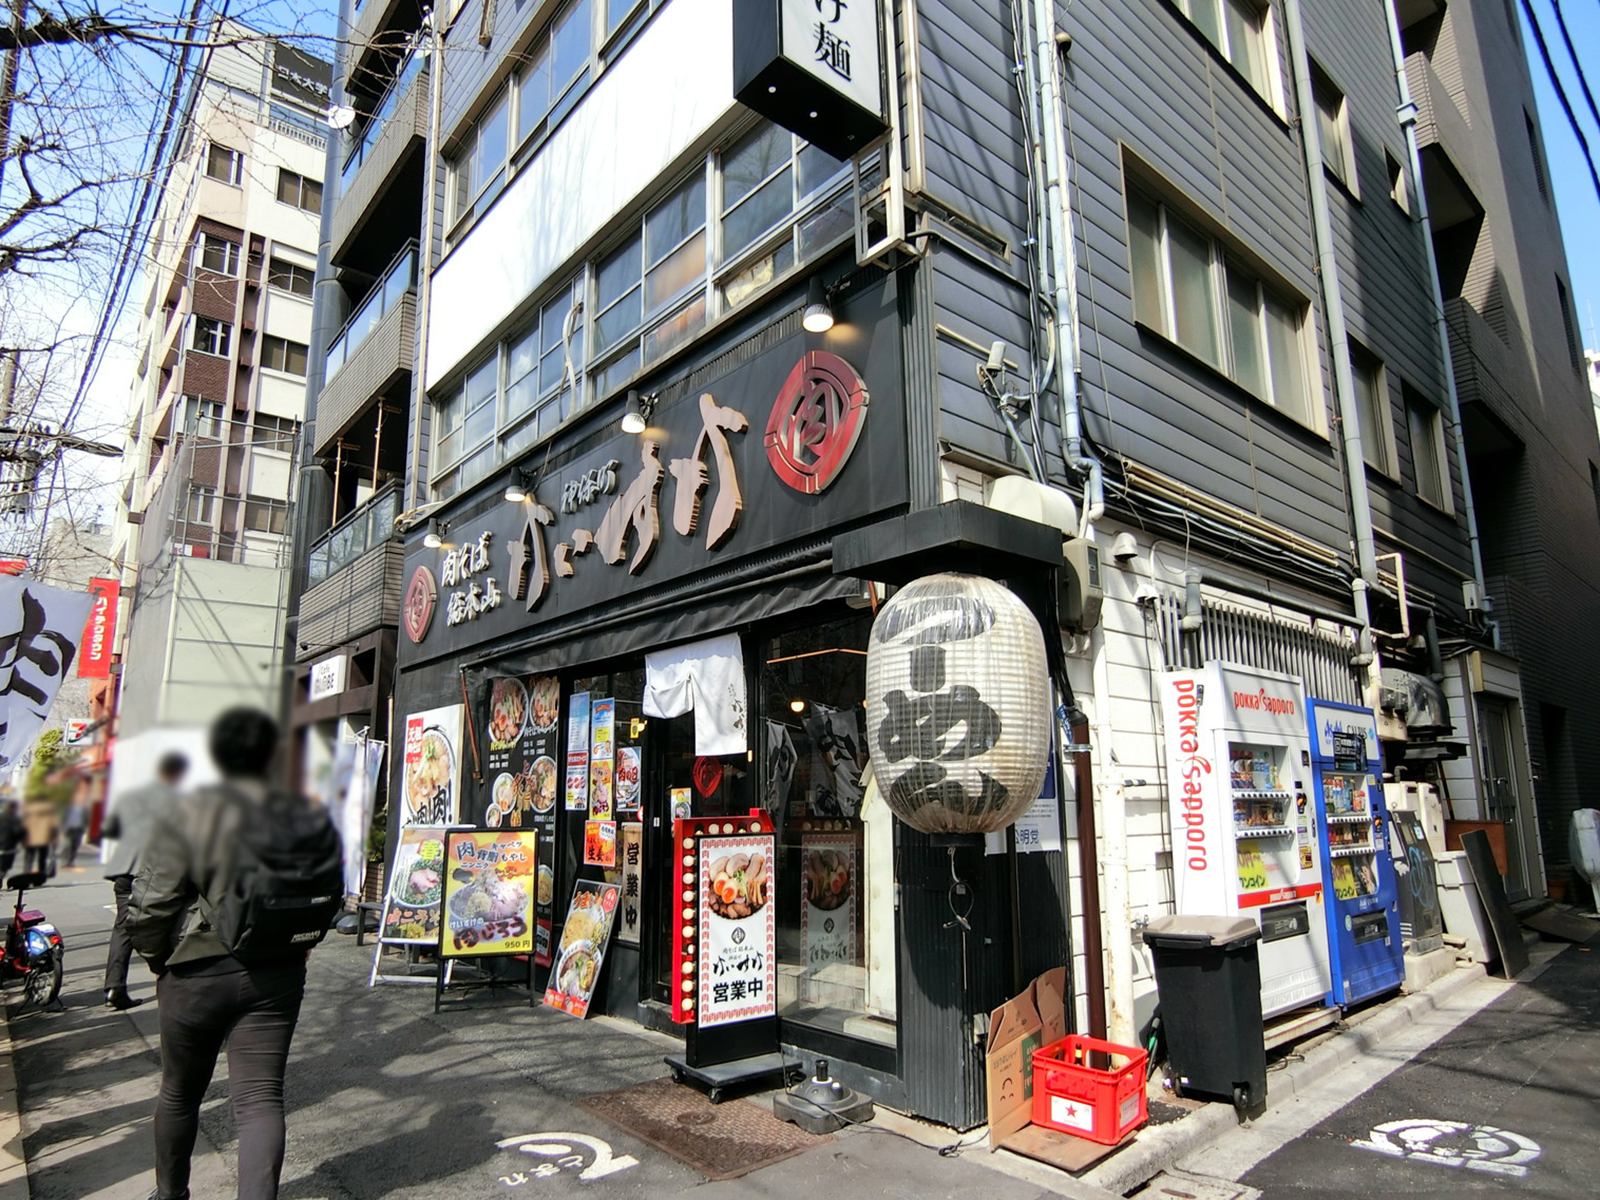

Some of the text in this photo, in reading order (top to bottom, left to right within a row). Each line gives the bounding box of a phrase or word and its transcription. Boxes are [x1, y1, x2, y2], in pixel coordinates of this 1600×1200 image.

[277, 65, 328, 95] 日本大学
[441, 531, 492, 588] 肉そば
[456, 841, 475, 861] 肉
[491, 841, 523, 850] キャベツ
[501, 853, 527, 862] もやし
[626, 842, 639, 929] 営業中
[505, 940, 530, 949] 950円
[713, 977, 763, 1004] 営業中
